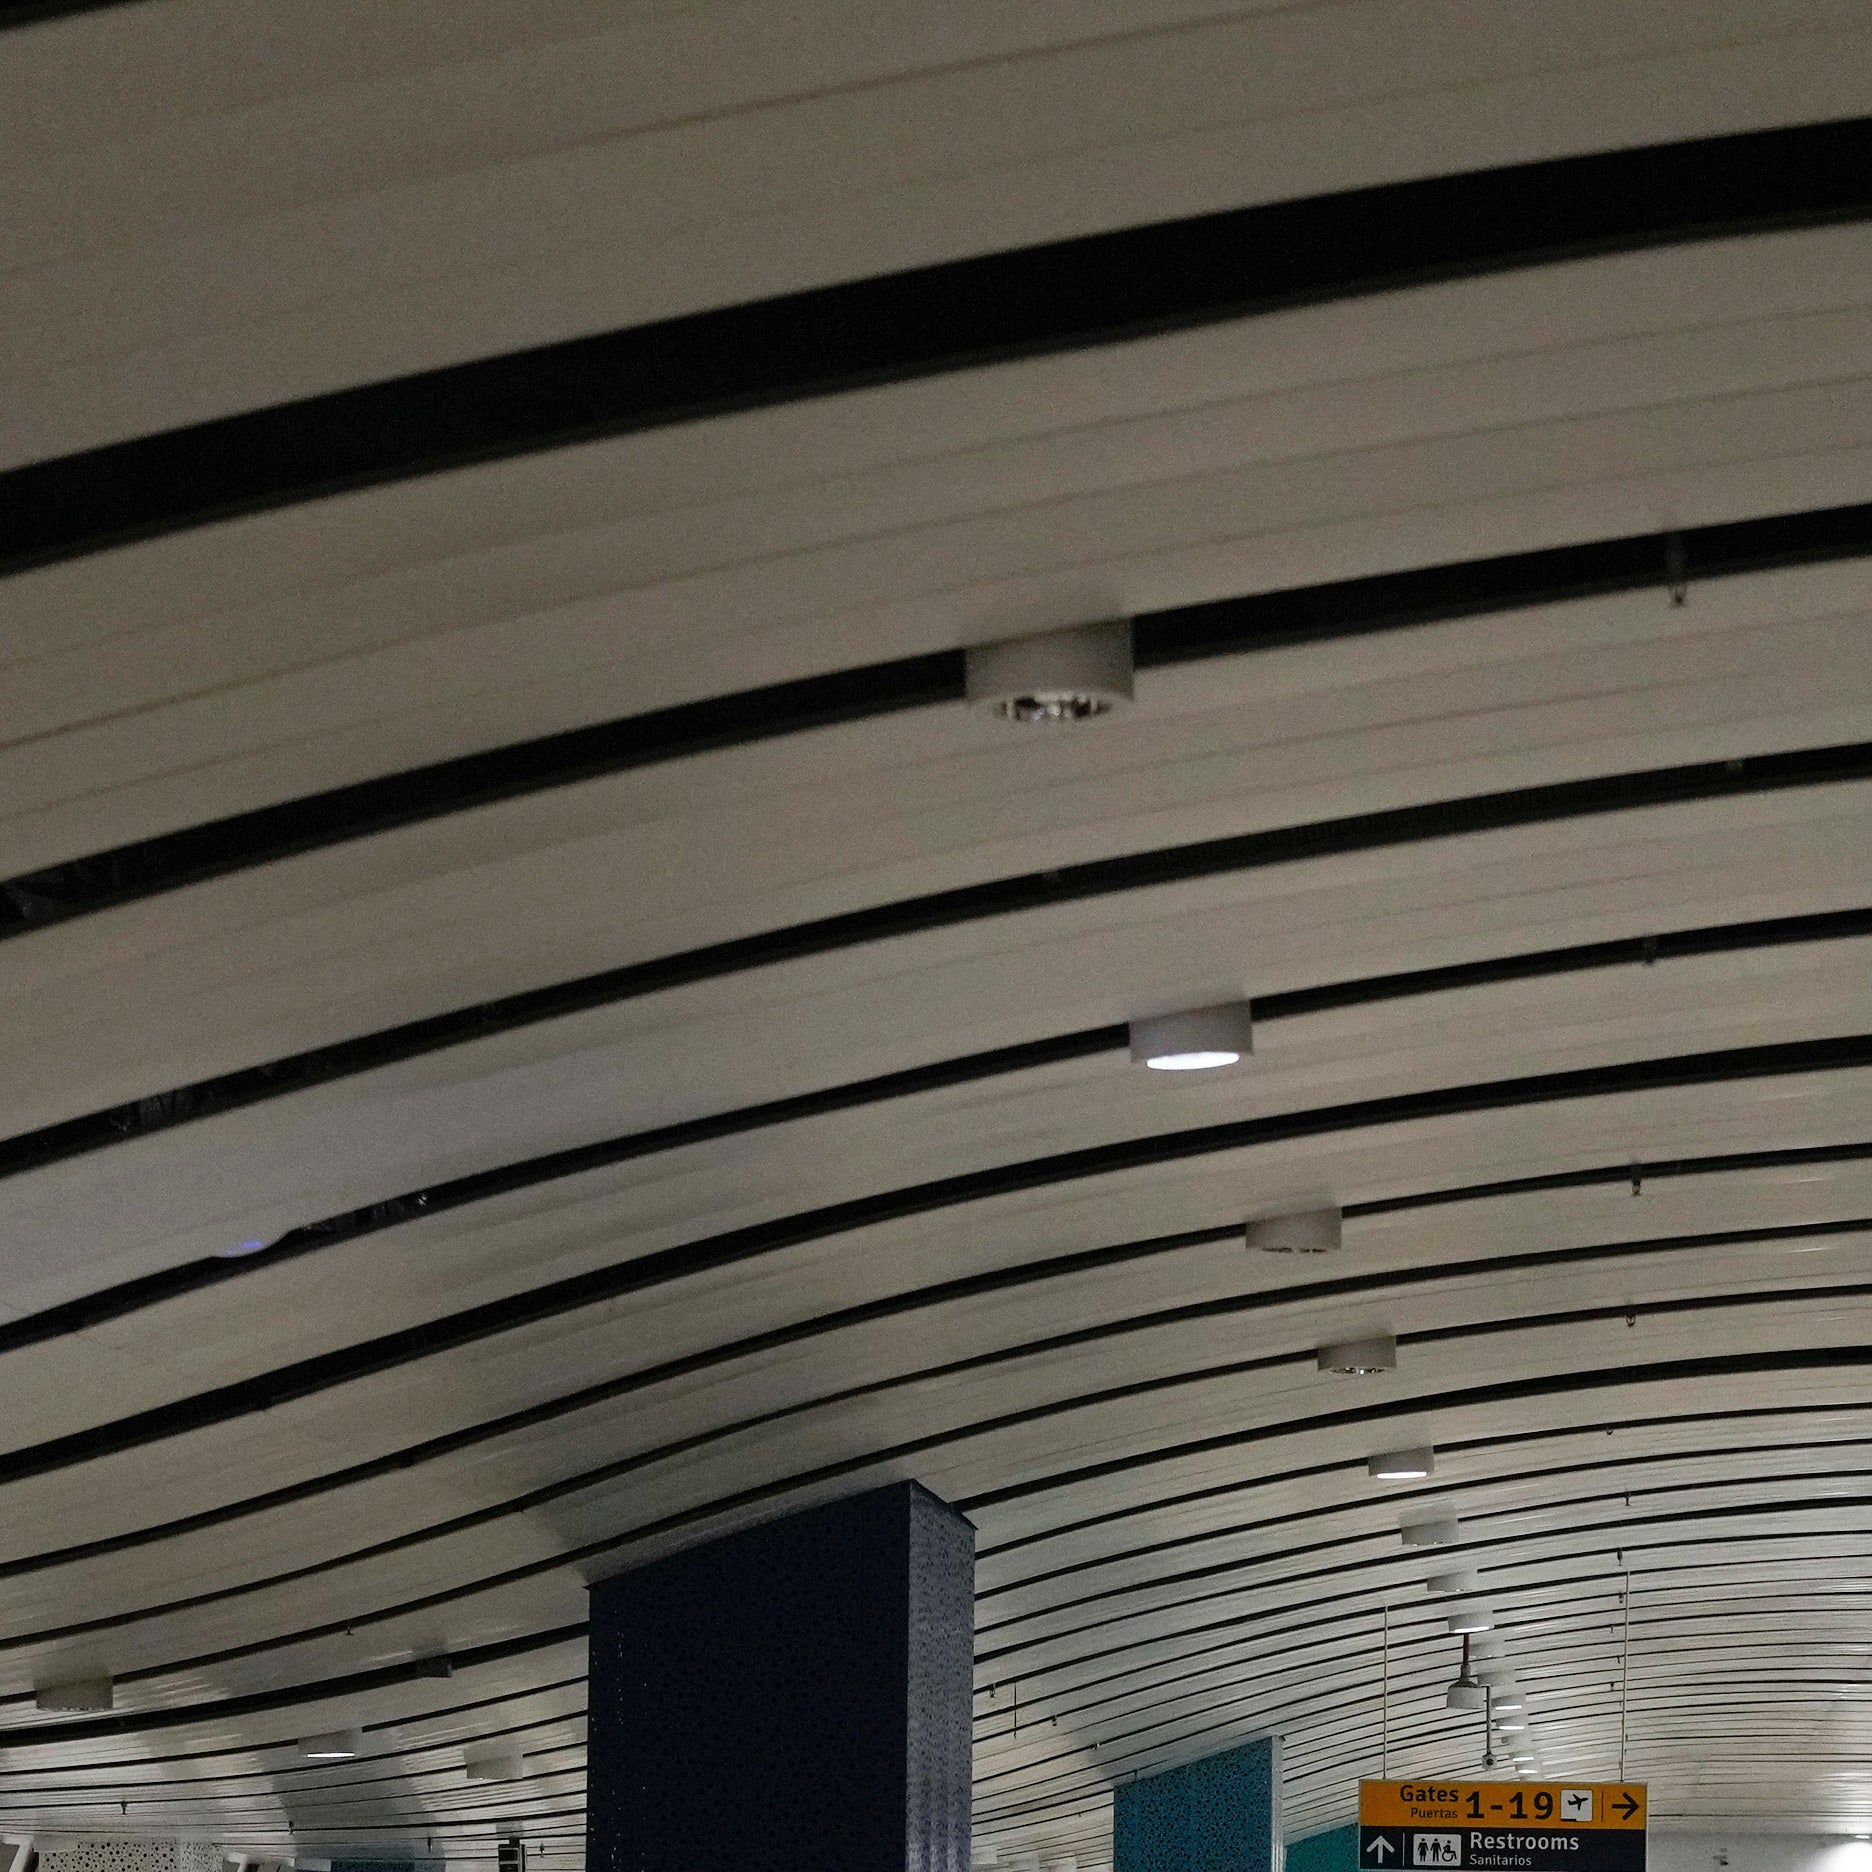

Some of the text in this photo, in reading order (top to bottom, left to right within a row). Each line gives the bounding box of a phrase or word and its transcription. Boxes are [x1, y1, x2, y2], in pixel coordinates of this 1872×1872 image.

[1400, 1785, 1553, 1820] Gates 1-19
[1411, 1807, 1458, 1819] Puertas
[1470, 1831, 1579, 1851] Restrooms
[1469, 1853, 1532, 1867] Sanitarios
